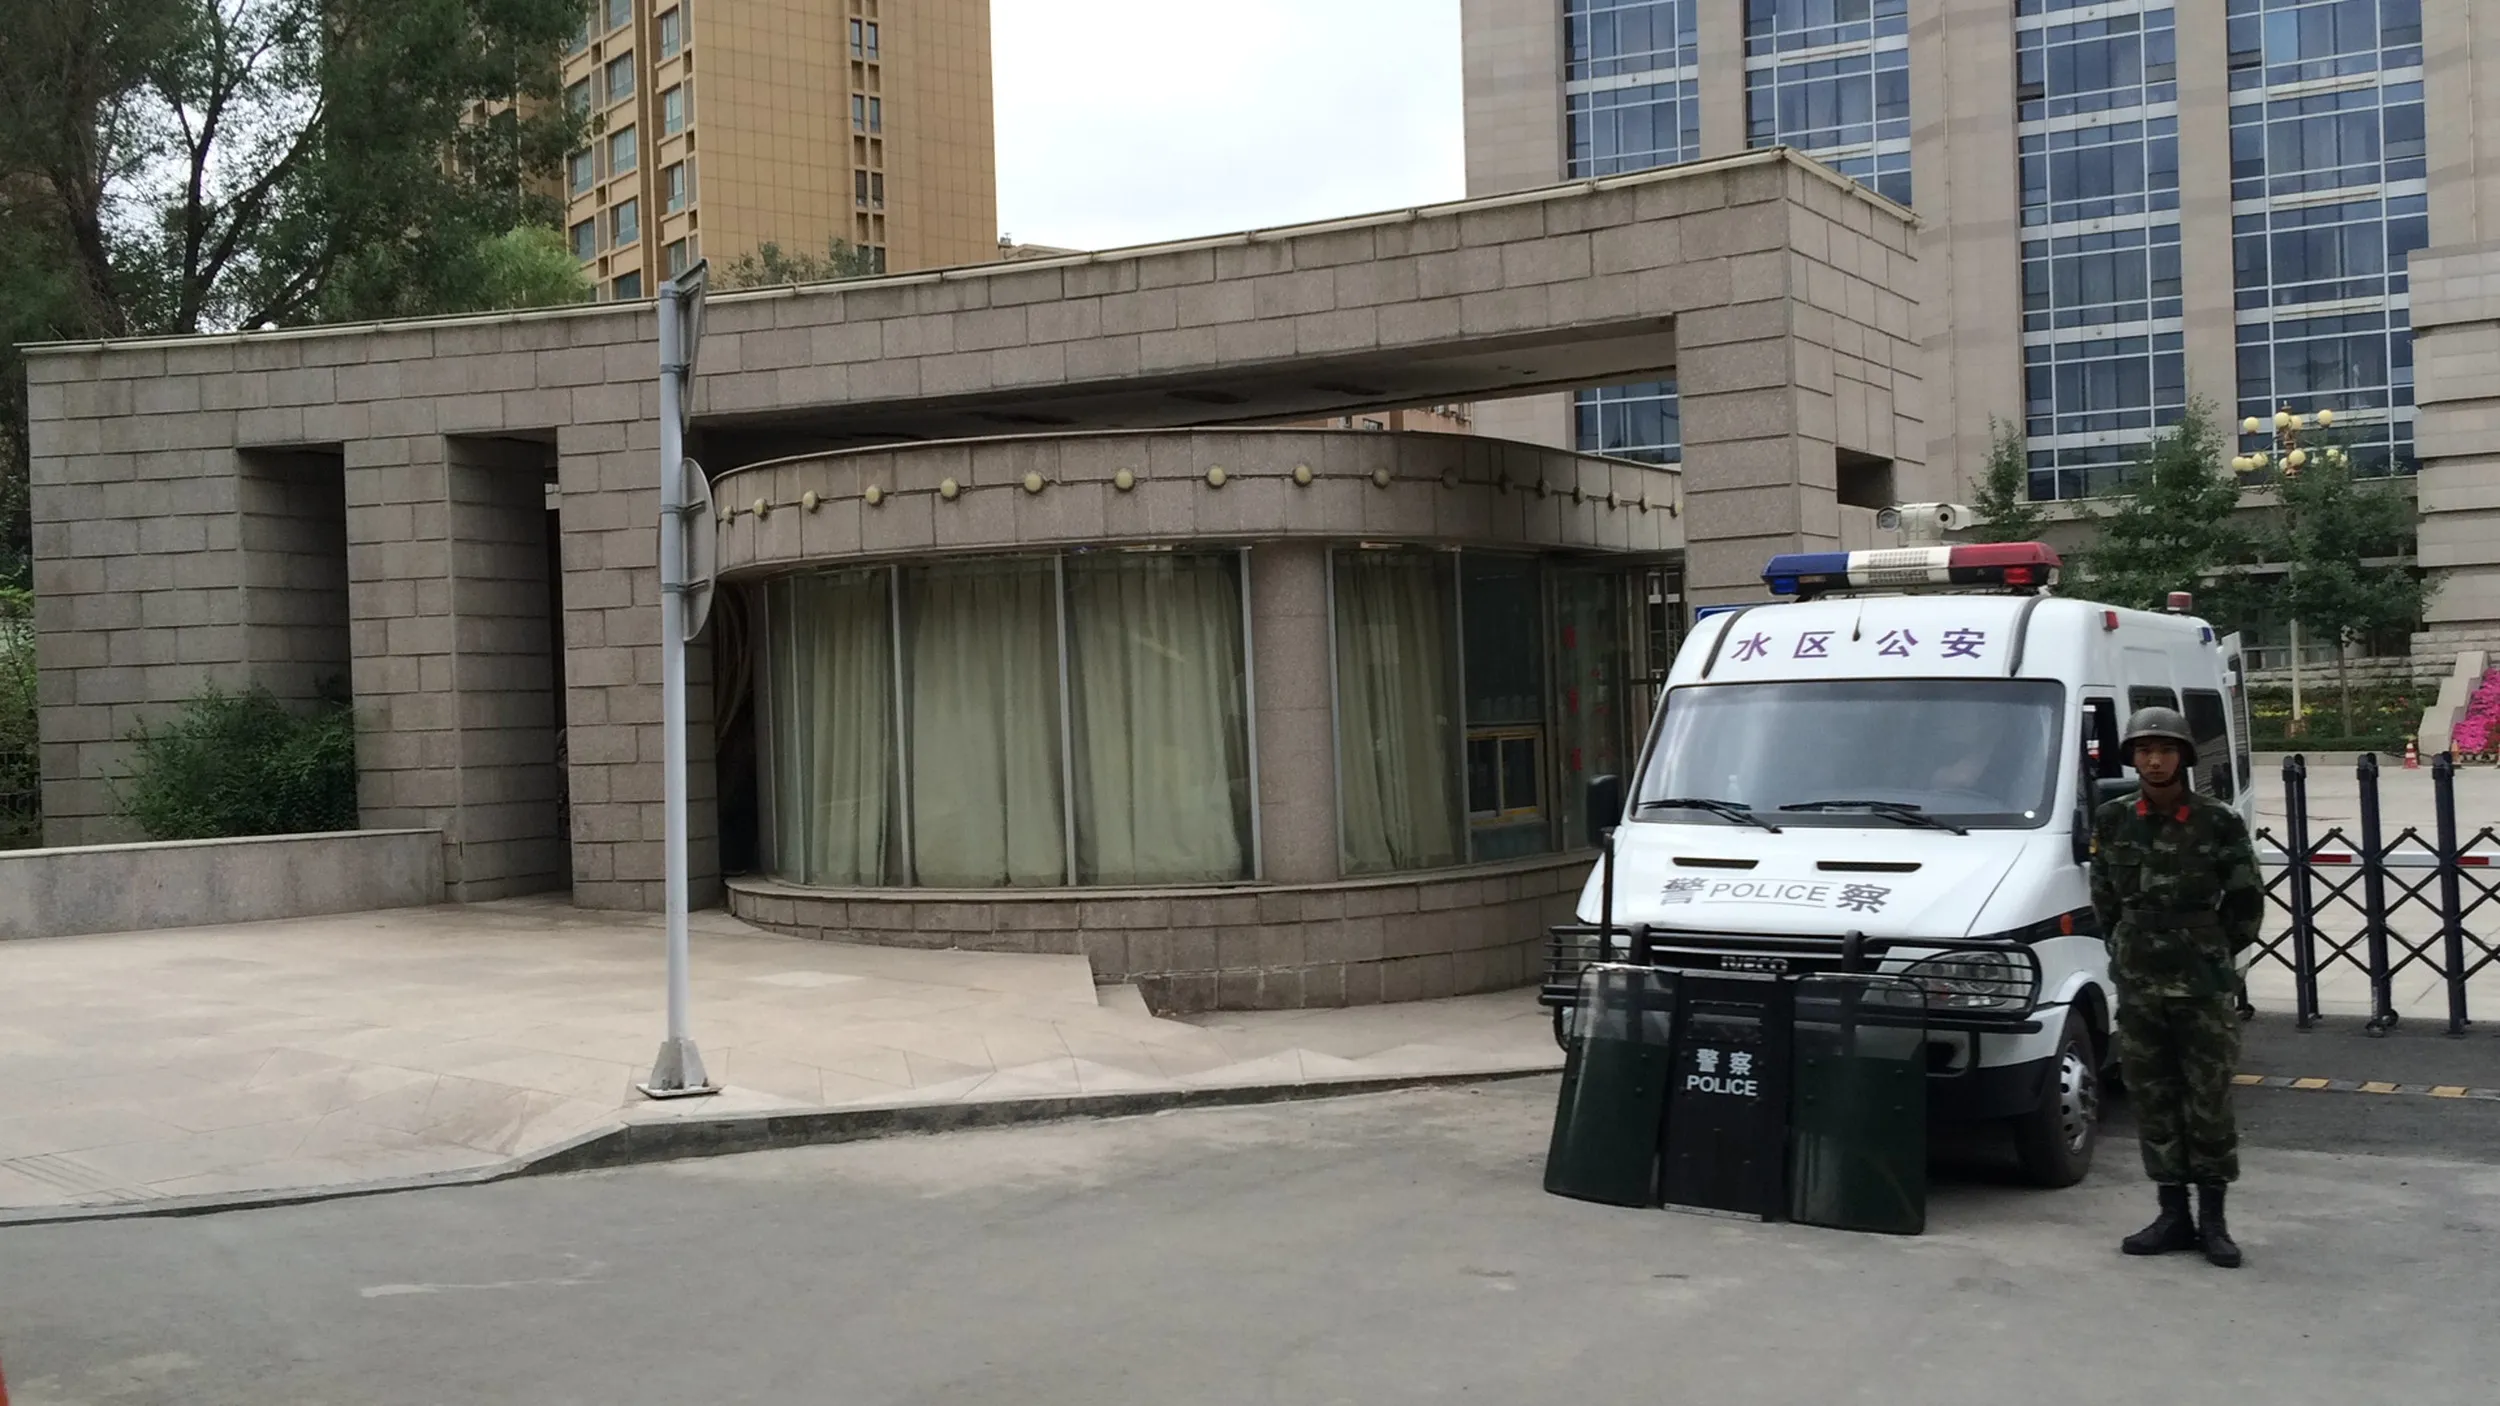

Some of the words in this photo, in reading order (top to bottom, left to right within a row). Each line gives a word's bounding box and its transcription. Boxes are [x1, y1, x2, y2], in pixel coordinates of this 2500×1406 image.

[1660, 876, 1709, 906] 警
[1709, 882, 1830, 902] POLICE
[1836, 883, 1892, 914] 察
[1696, 1048, 1752, 1075] 警察
[1686, 1074, 1758, 1097] POLICE
